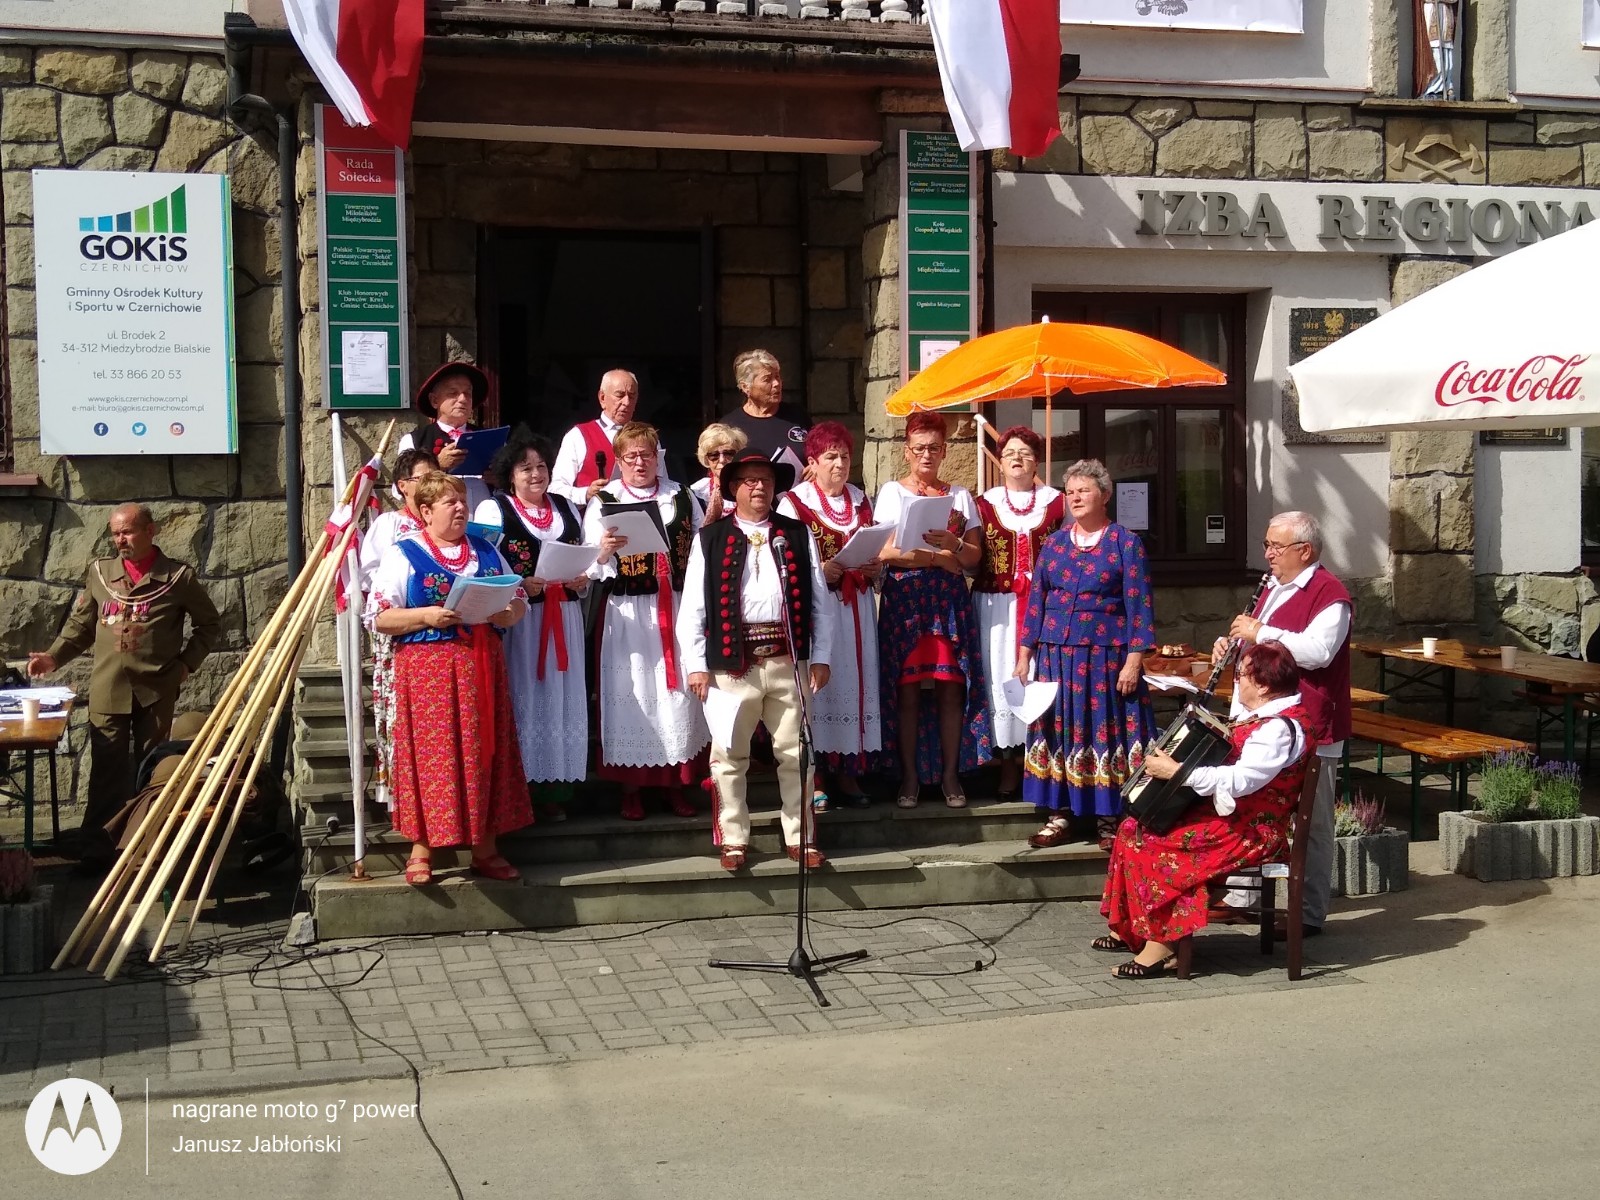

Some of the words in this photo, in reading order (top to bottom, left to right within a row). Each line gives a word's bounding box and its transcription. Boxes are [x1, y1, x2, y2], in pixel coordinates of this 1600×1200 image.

[346, 158, 374, 169] Rada
[339, 171, 382, 183] Sołecka
[1136, 189, 1287, 238] IZBA
[79, 234, 188, 262] GOKiS
[66, 286, 110, 299] Gminny
[114, 286, 160, 298] Ośrodek
[163, 288, 204, 300] Kultury
[75, 302, 113, 314] Sportu
[128, 302, 202, 313] Czernichowie
[122, 330, 156, 340] Brodek
[159, 331, 166, 340] 2
[61, 343, 98, 353] 34-312
[174, 344, 211, 354] Bialskie
[110, 370, 124, 379] 33
[127, 370, 148, 379] 866
[151, 370, 166, 380] 20
[168, 370, 182, 380] 53
[1435, 354, 1592, 407] Coca-Cola
